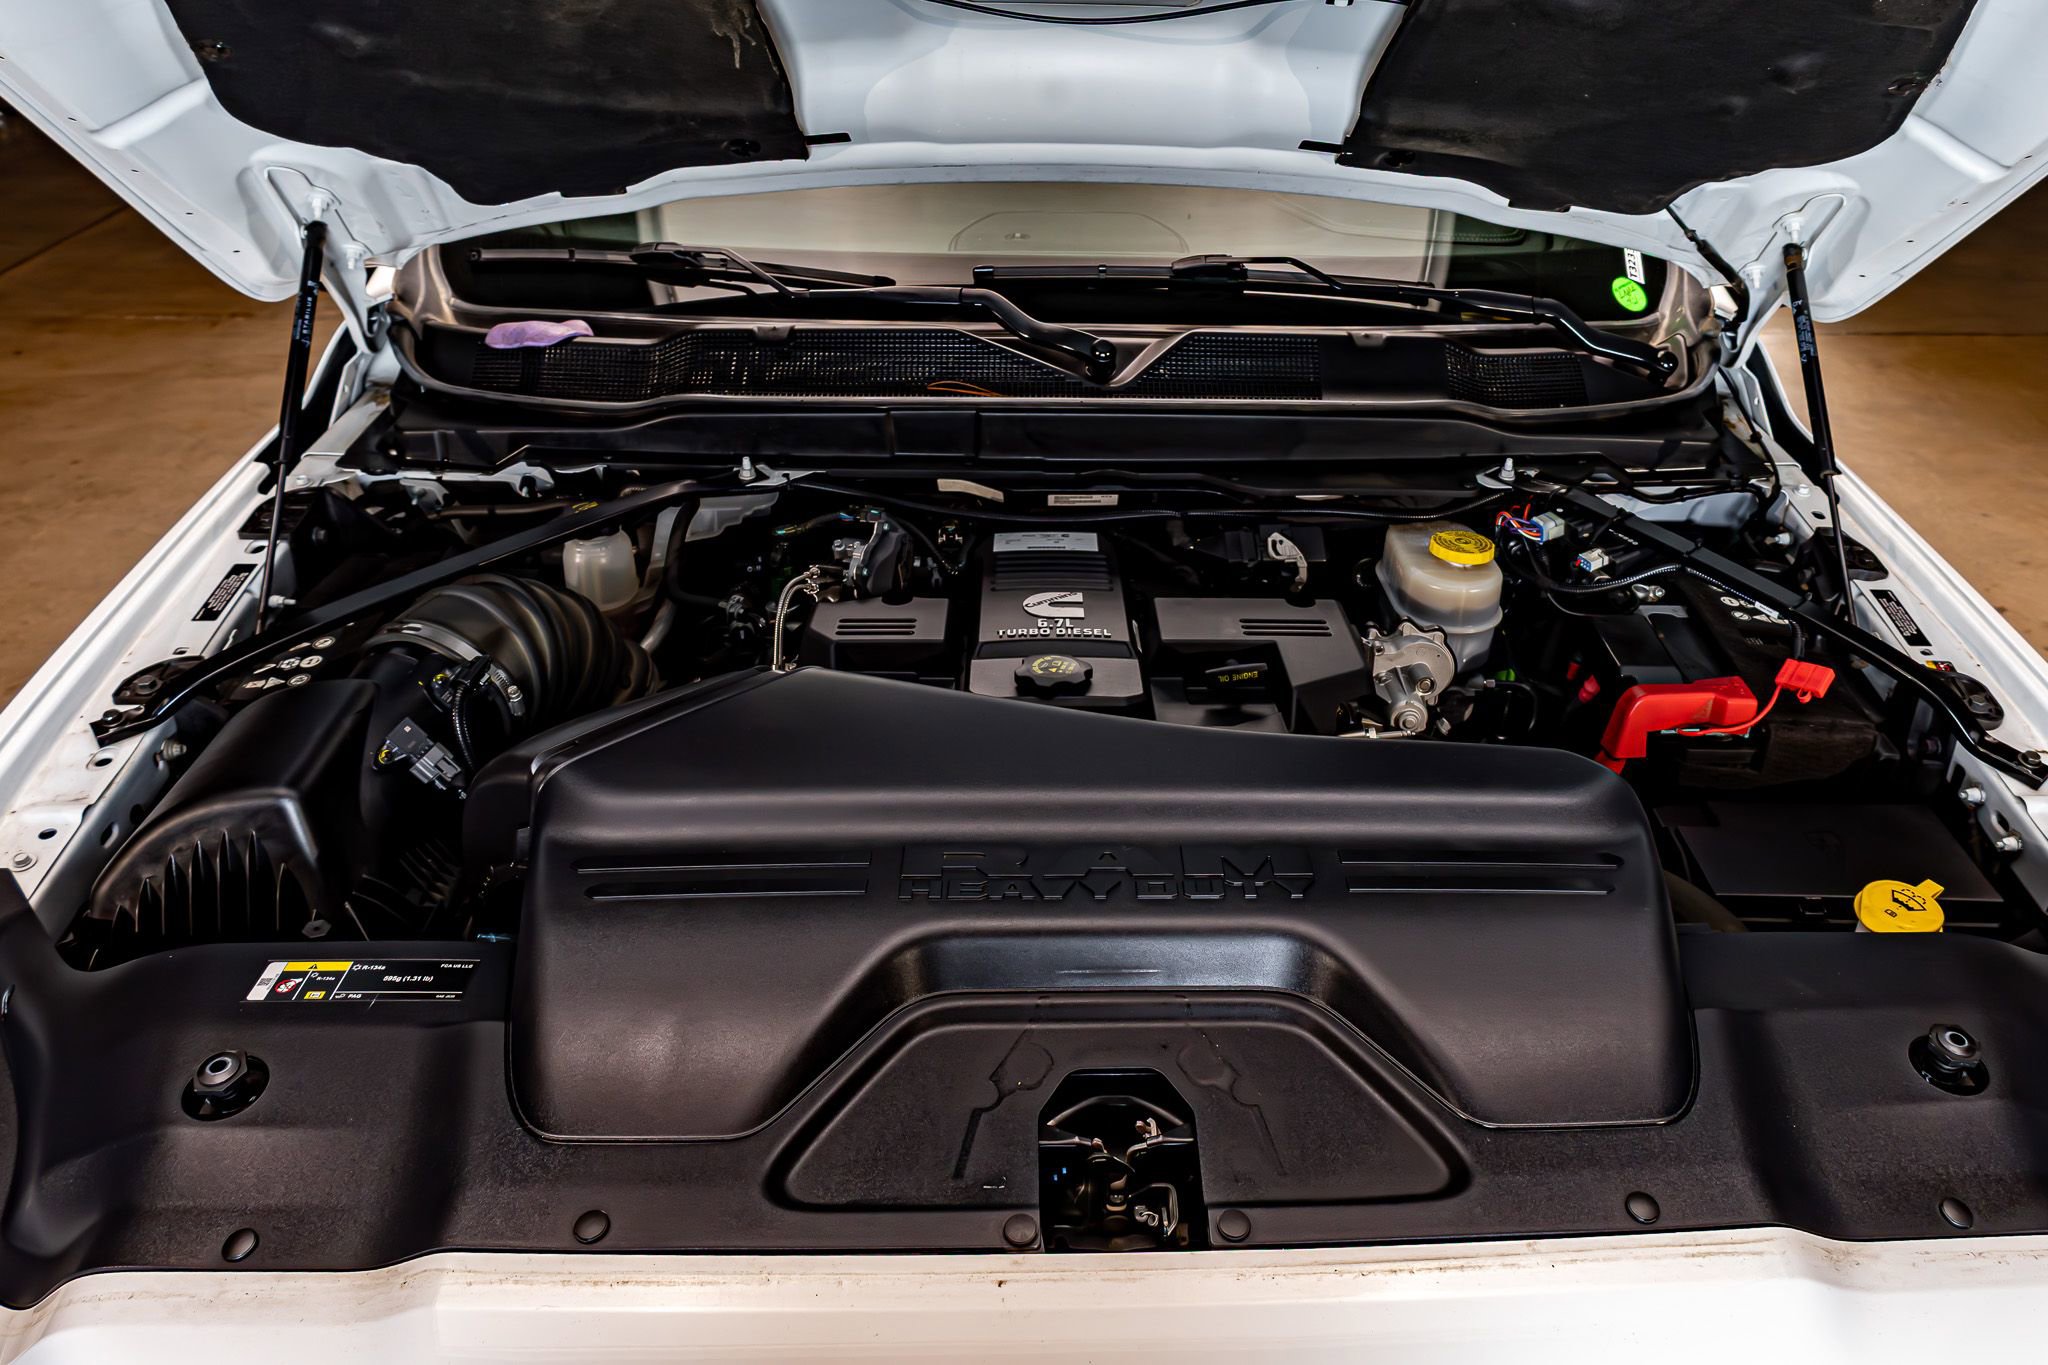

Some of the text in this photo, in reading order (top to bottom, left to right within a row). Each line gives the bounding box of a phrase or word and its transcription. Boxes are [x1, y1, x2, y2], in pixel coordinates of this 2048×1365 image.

[1024, 592, 1078, 608] Cummins
[1037, 618, 1074, 628] 6.7L
[998, 628, 1112, 637] TURBO DIESEL
[900, 844, 1316, 878] RAM
[898, 878, 1316, 900] HEAVY DUTY
